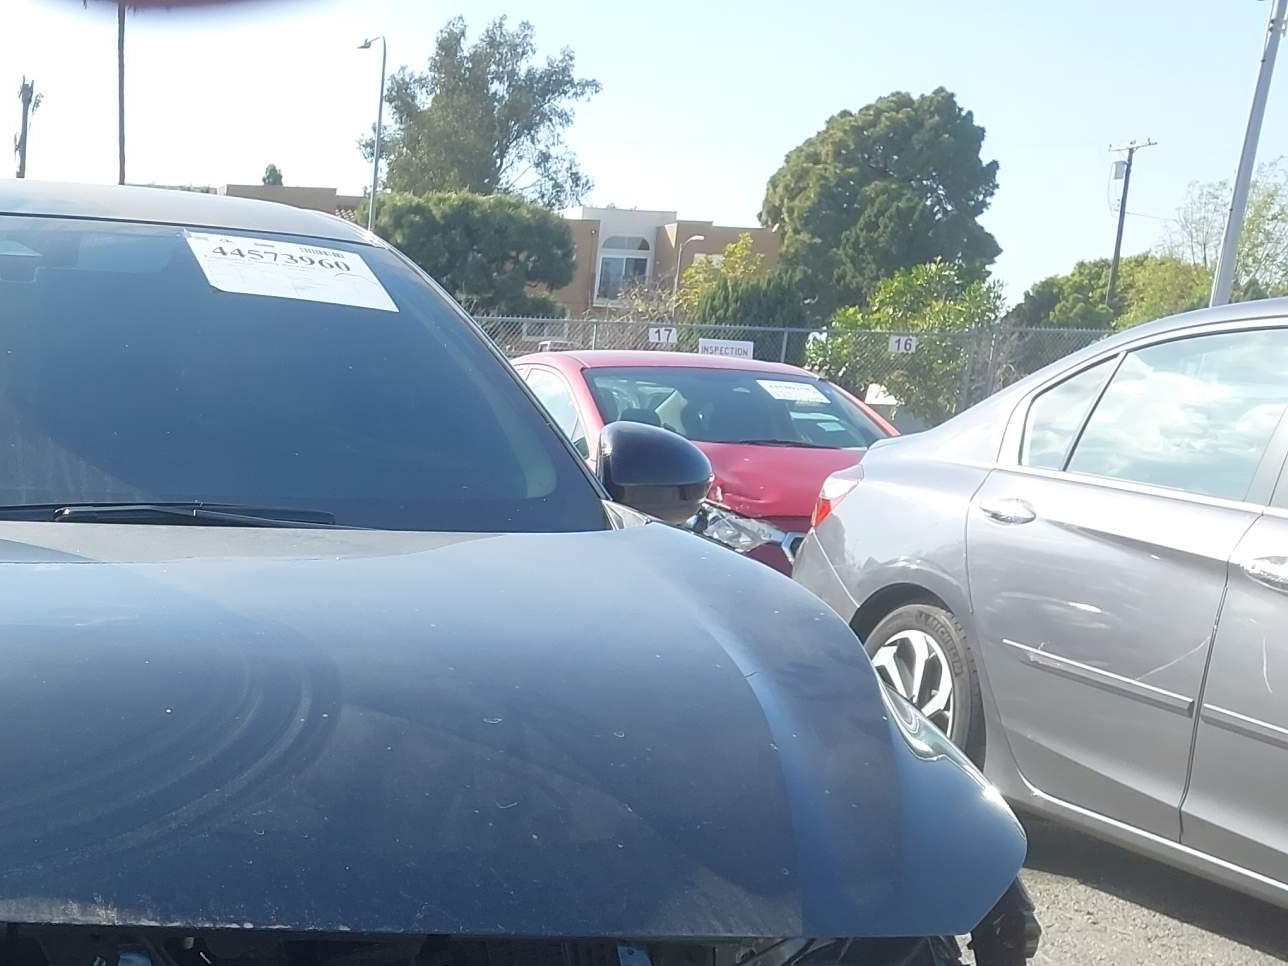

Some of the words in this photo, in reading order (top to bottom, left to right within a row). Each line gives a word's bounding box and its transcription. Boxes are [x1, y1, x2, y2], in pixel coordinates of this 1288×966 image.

[212, 246, 351, 272] 44573960
[654, 328, 672, 342] 17
[702, 345, 748, 356] INSPECTION
[894, 338, 912, 352] 16
